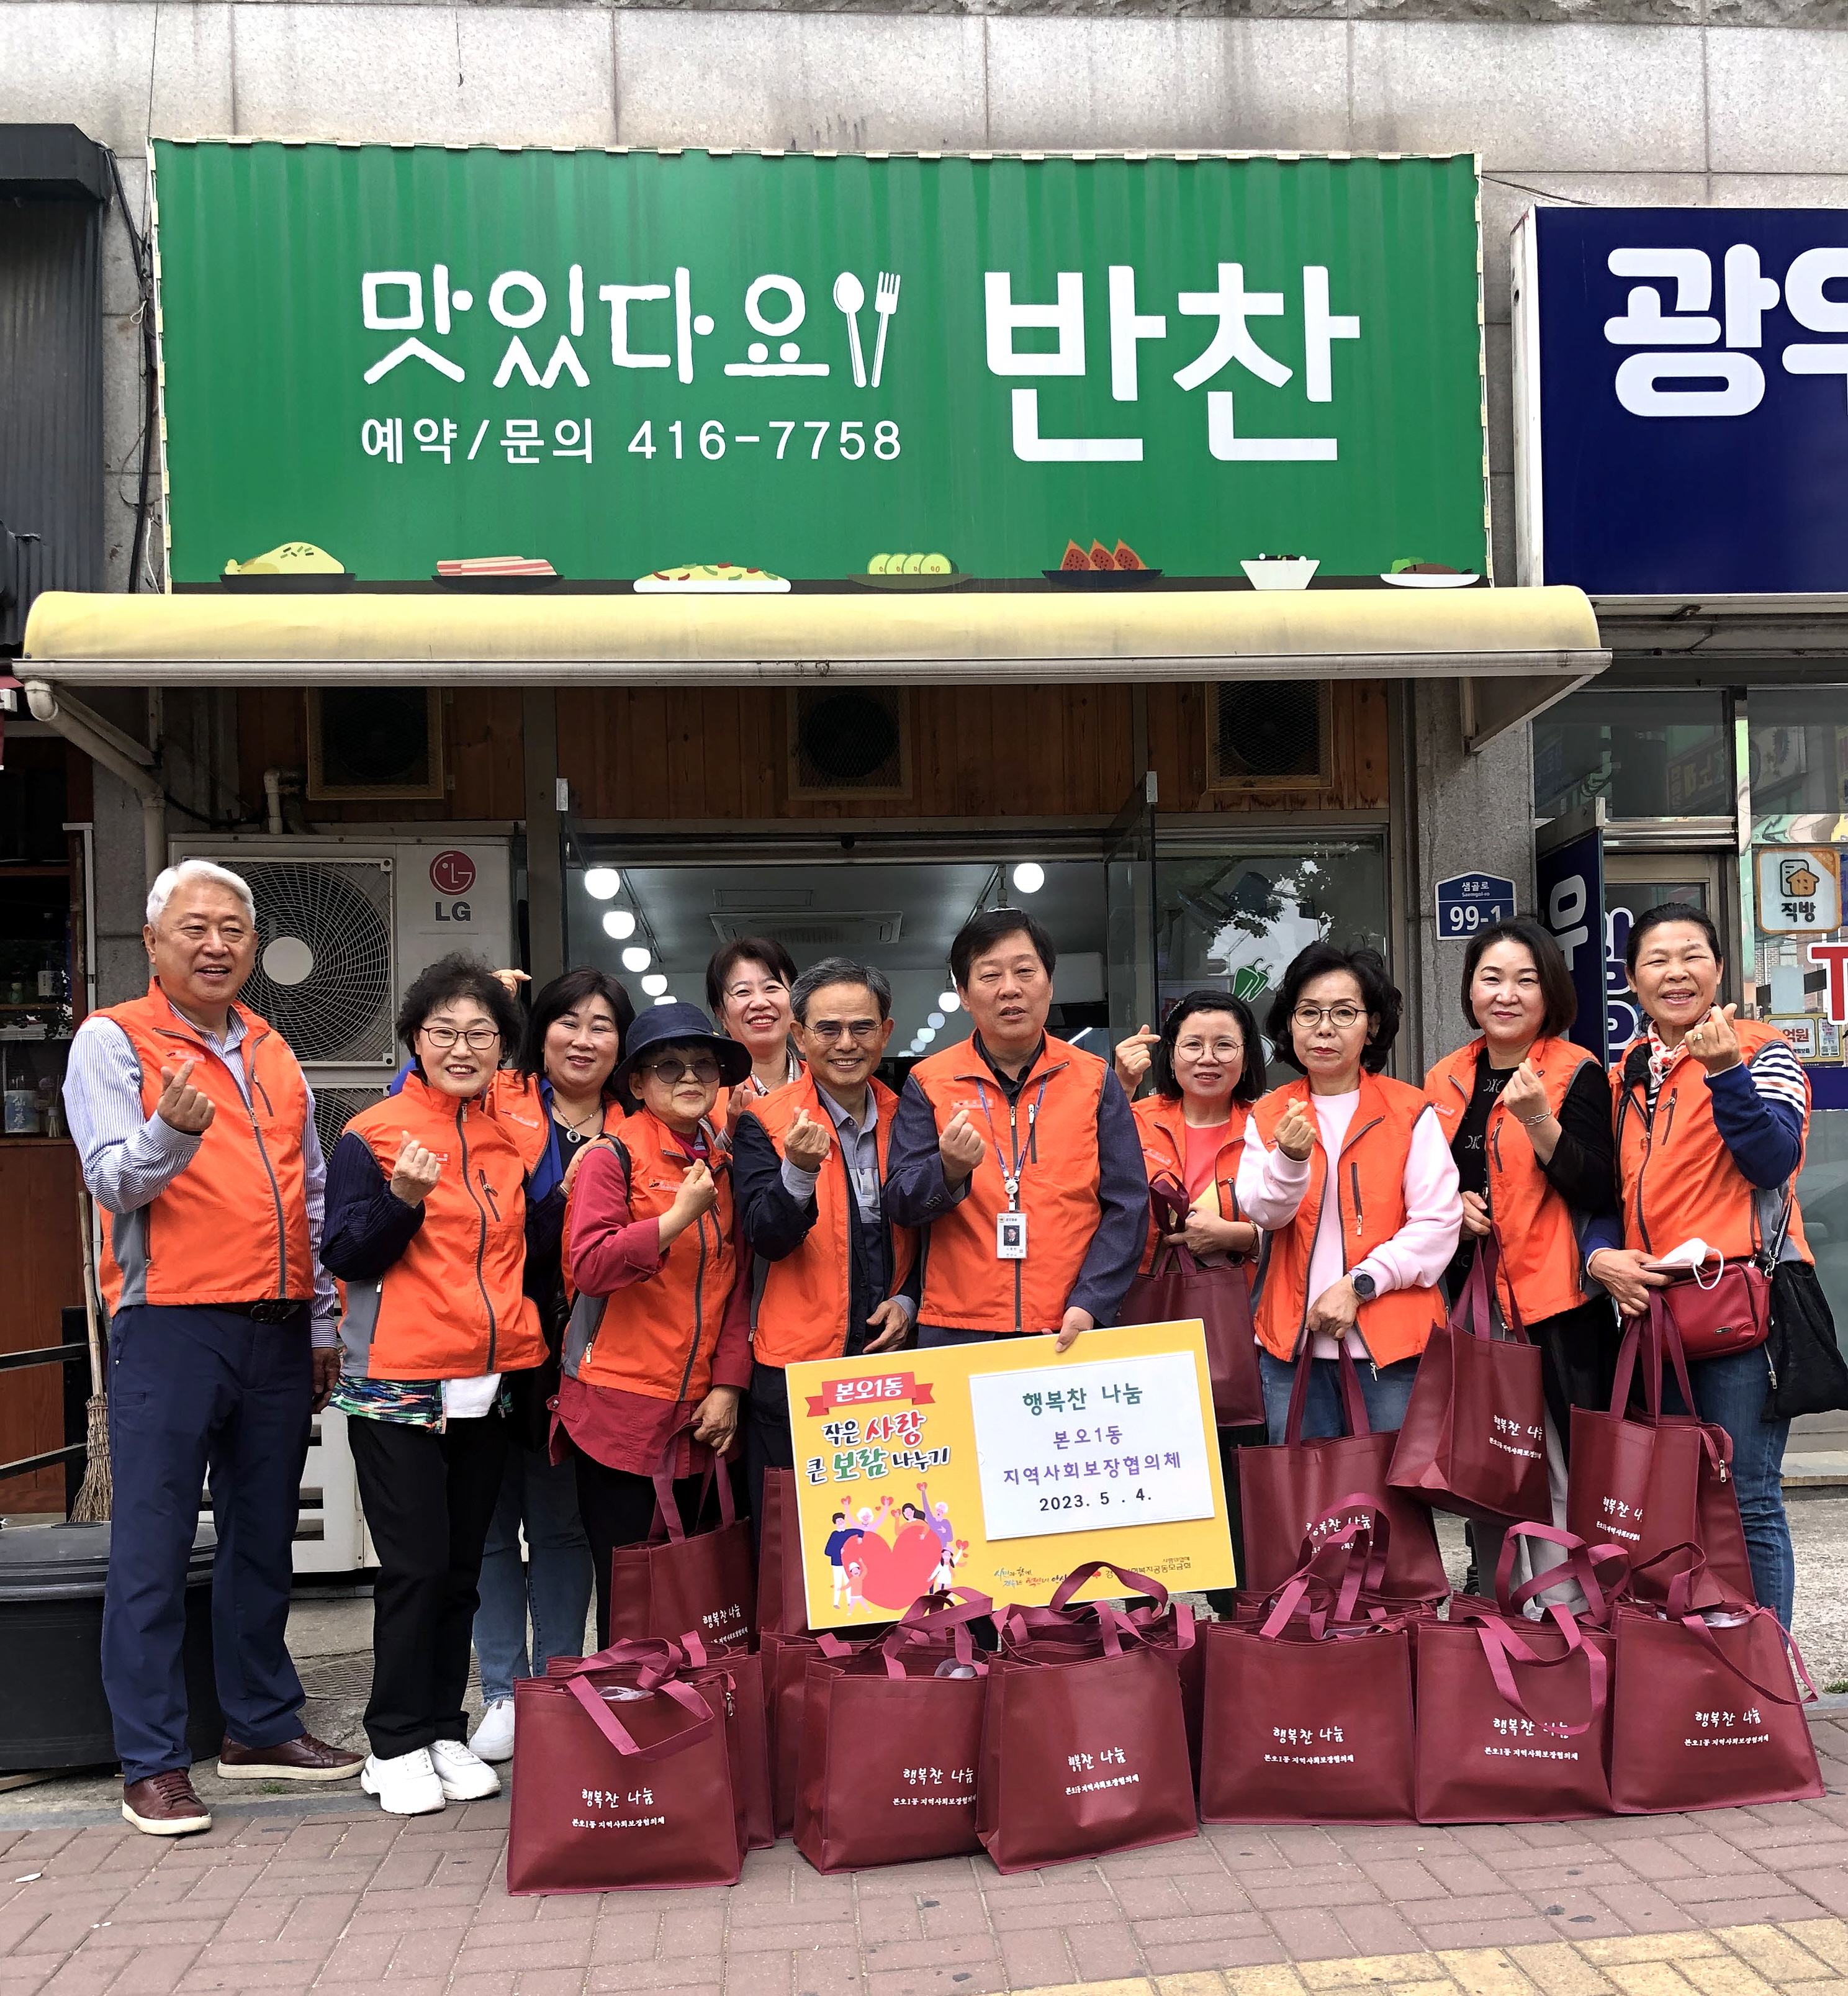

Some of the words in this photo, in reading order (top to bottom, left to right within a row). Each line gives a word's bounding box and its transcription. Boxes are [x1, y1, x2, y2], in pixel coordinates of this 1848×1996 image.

[362, 264, 830, 388] 맛있다요
[985, 263, 1361, 462] 반찬
[362, 418, 593, 464] 예약/문의
[628, 420, 902, 461] 416-7758
[1461, 881, 1490, 892] 샘골로
[435, 901, 471, 921] LG
[1449, 905, 1502, 931] 99-1
[1781, 901, 1816, 923] 직방
[835, 1376, 904, 1403] 본오1동
[1022, 1387, 1088, 1416] 행복찬
[1101, 1382, 1143, 1405] 나눔
[823, 1420, 859, 1445] 작은
[865, 1411, 926, 1446] 사랑
[1494, 1414, 1521, 1437] 행복찬
[1053, 1425, 1123, 1450] 본오1동
[807, 1458, 827, 1483] 큰
[833, 1447, 889, 1480] 보람
[892, 1447, 949, 1471] 나누기
[1003, 1452, 1181, 1486] 지역사회보장협의체
[1040, 1494, 1090, 1511] 2023.
[1603, 1496, 1630, 1518] 행복찬
[702, 1609, 728, 1628] 행복찬
[728, 1604, 741, 1619] 나눔
[1493, 1717, 1536, 1736] 행복찬
[1695, 1711, 1736, 1728] 행복찬
[1742, 1707, 1761, 1725] 나눔
[1273, 1727, 1314, 1745] 행복찬
[1319, 1725, 1344, 1743] 나눔
[1068, 1753, 1094, 1772] 행복찬
[1100, 1746, 1127, 1764] 나눔
[903, 1767, 944, 1786] 행복찬
[951, 1768, 974, 1784] 나눔
[582, 1788, 620, 1809] 행복찬
[628, 1787, 654, 1805] 나눔
